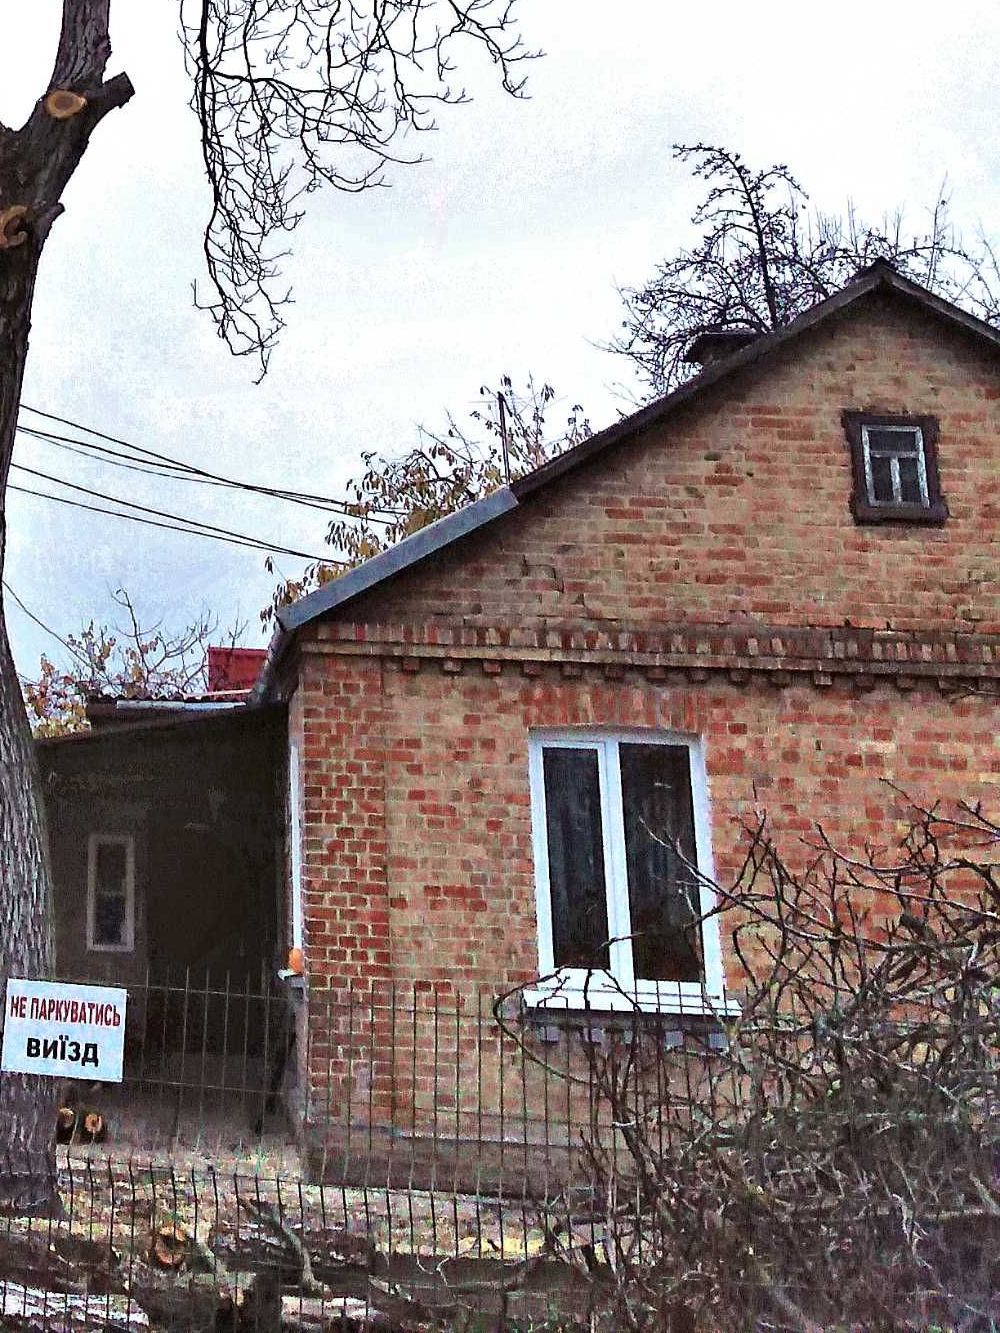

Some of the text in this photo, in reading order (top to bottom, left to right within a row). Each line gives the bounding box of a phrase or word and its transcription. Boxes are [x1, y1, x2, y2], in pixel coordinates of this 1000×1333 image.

[10, 995, 121, 1026] НЕ ПАРКУВАТИСЬ
[26, 1035, 99, 1067] ВИЇЗД
